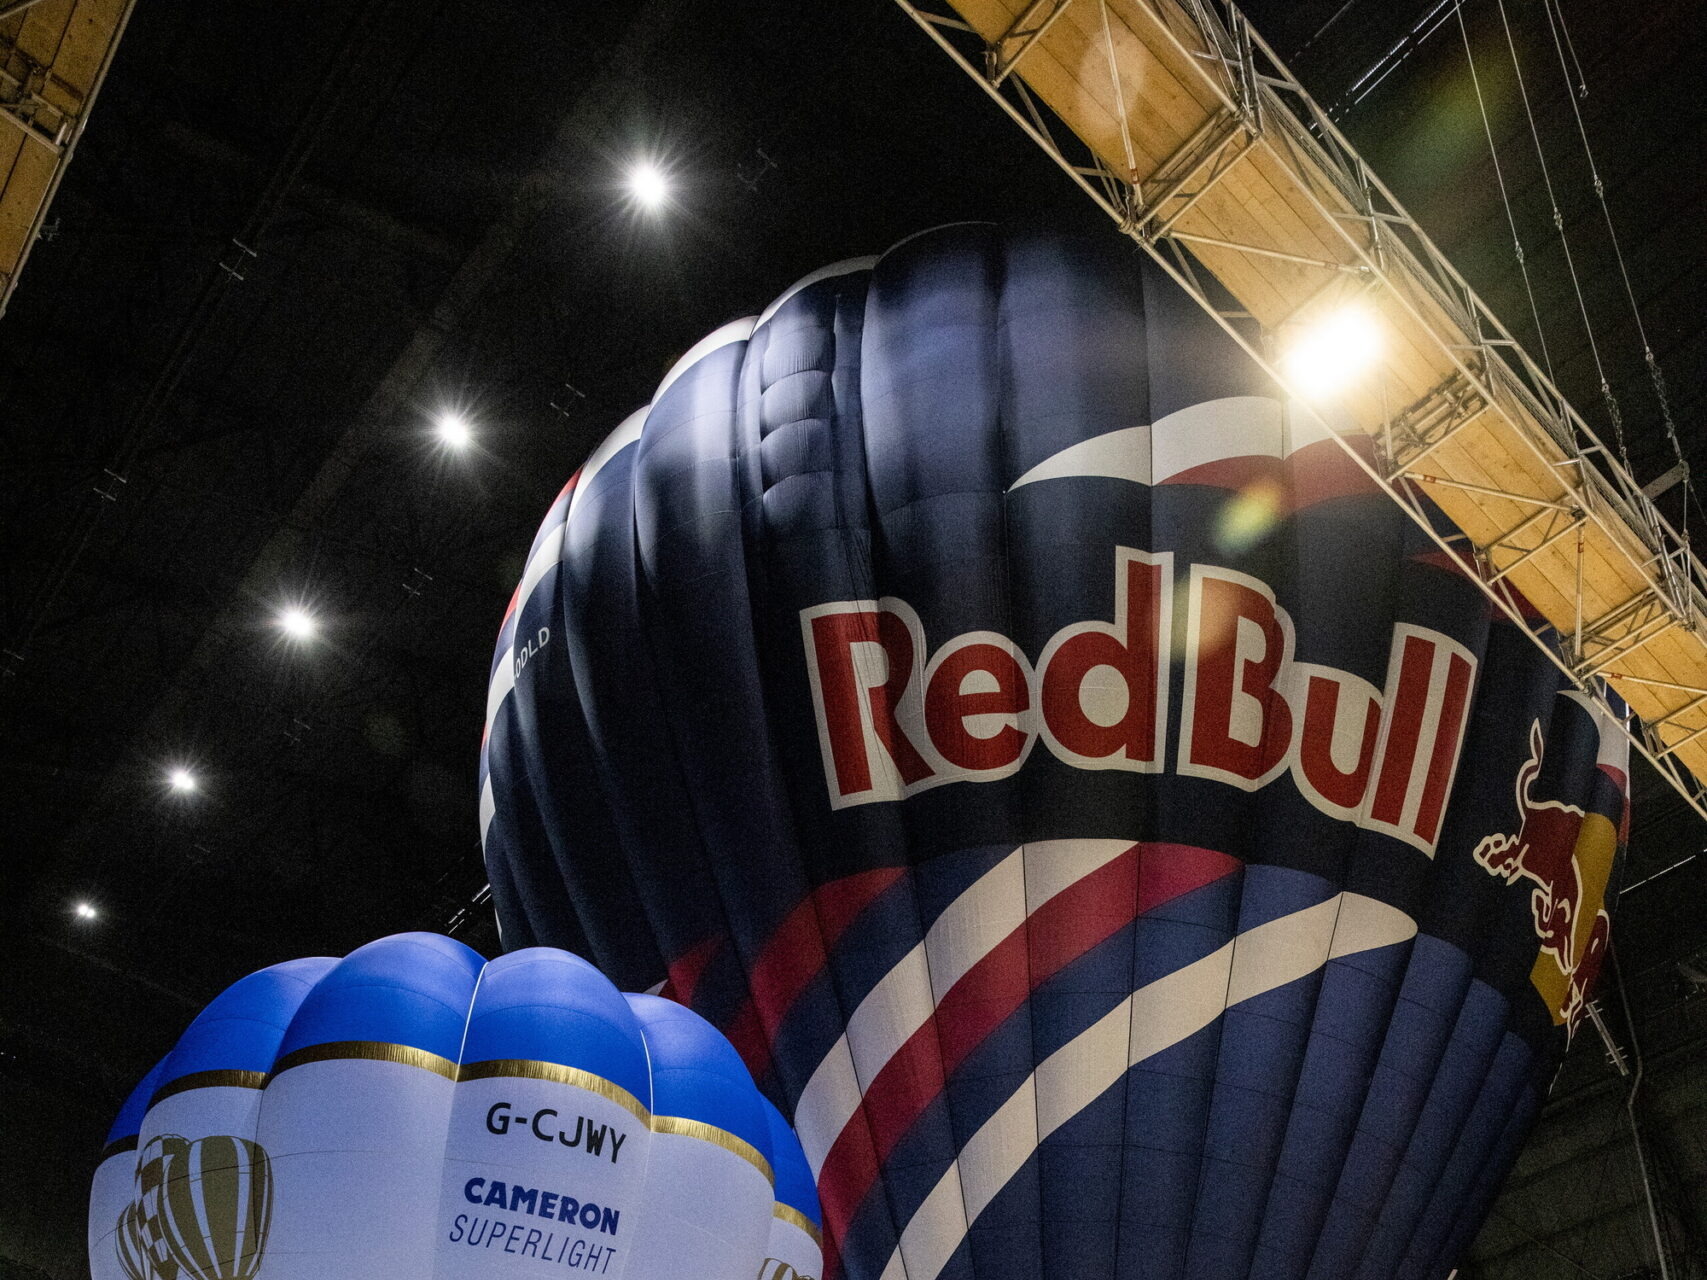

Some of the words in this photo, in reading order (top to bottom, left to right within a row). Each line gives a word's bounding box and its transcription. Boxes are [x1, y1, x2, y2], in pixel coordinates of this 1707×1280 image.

[800, 545, 1174, 811] Red
[1176, 563, 1479, 861] Bull
[486, 1102, 627, 1164] G-CJWY
[464, 1177, 620, 1236] CAMERON
[449, 1213, 617, 1275] SUPERLIGHT
